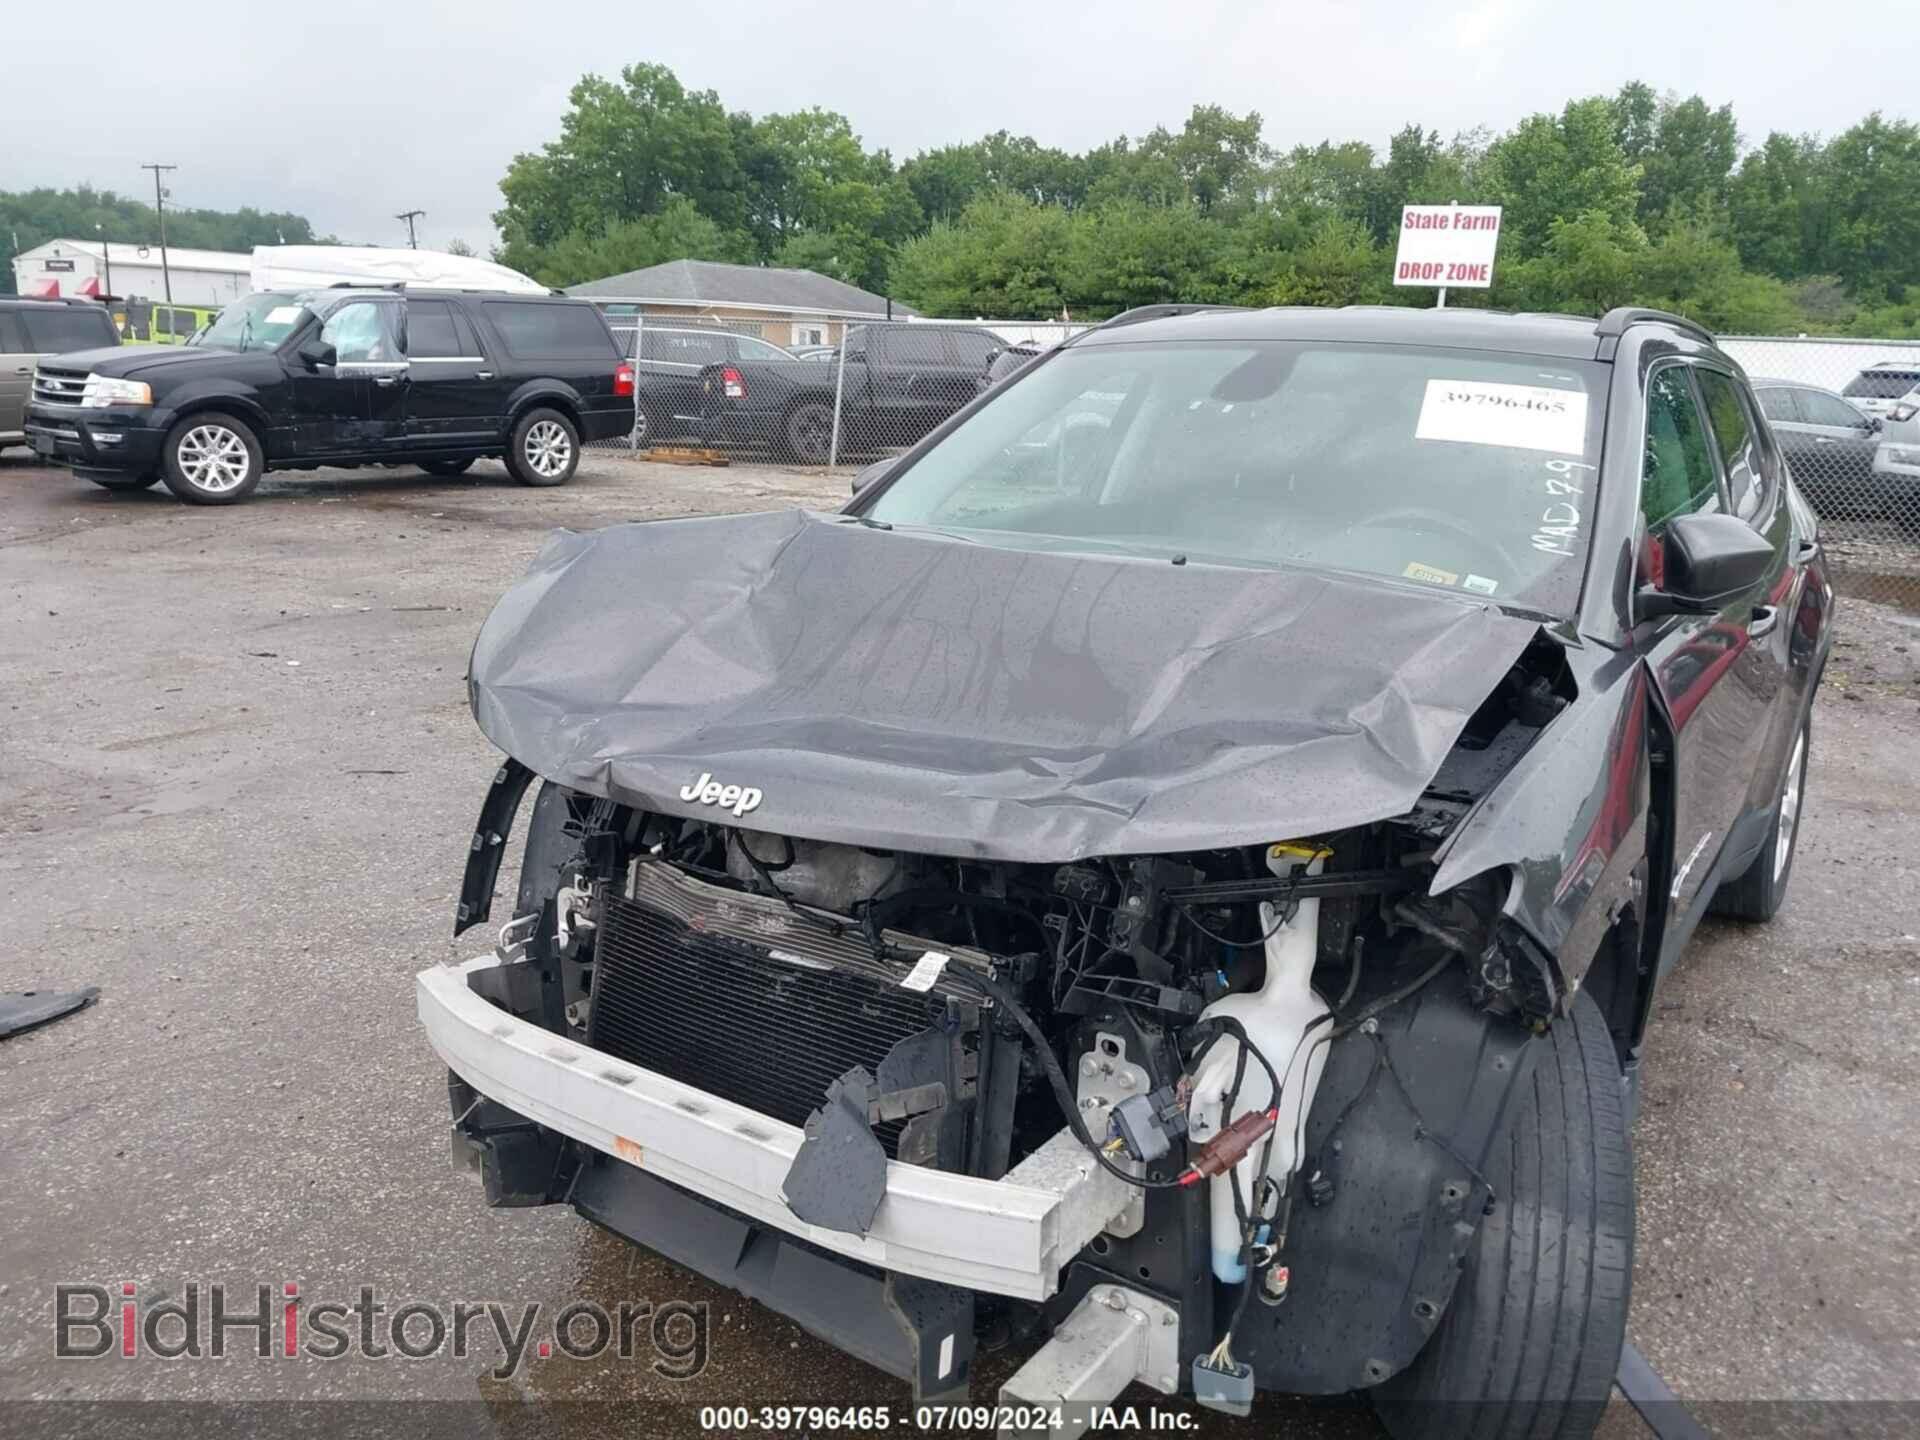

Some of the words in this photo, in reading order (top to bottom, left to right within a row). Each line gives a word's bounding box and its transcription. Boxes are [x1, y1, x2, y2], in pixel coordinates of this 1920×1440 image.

[1404, 212, 1449, 229] State
[1453, 212, 1497, 230] Farm
[1398, 262, 1444, 280] DROP
[1446, 263, 1488, 281] ZONE
[1440, 391, 1566, 414] 39796465
[680, 772, 763, 817] Jeep
